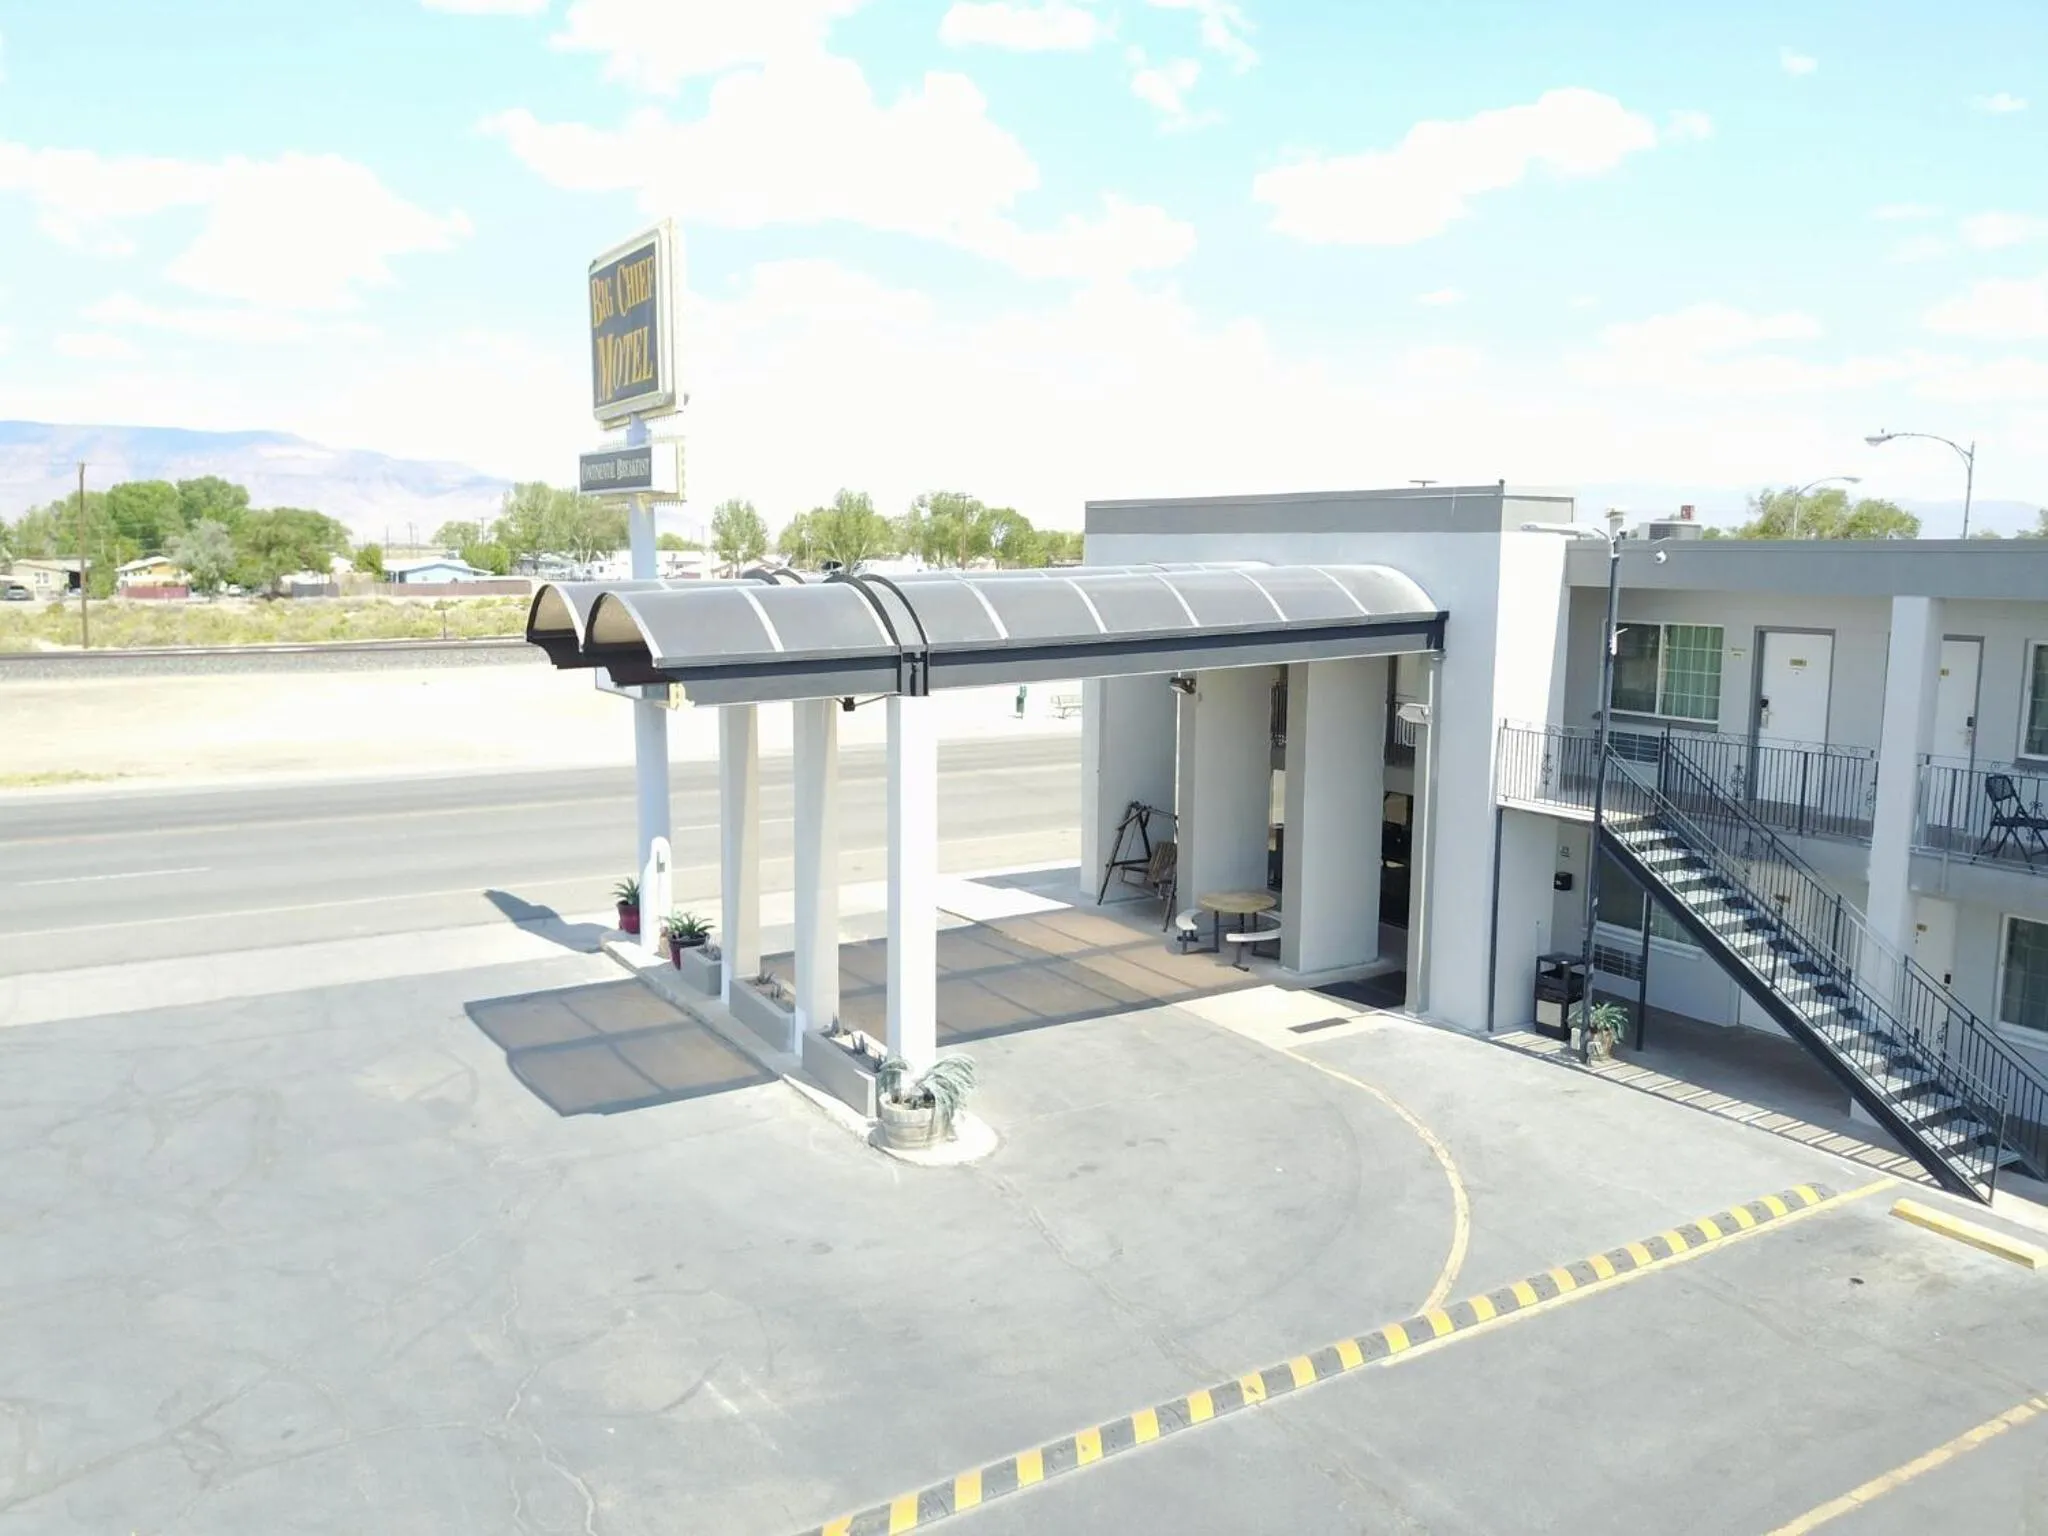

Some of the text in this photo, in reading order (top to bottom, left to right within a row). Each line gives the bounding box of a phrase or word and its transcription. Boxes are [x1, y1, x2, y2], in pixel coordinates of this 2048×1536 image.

[592, 256, 655, 328] BIG CHIEF
[597, 327, 654, 401] MOTEL
